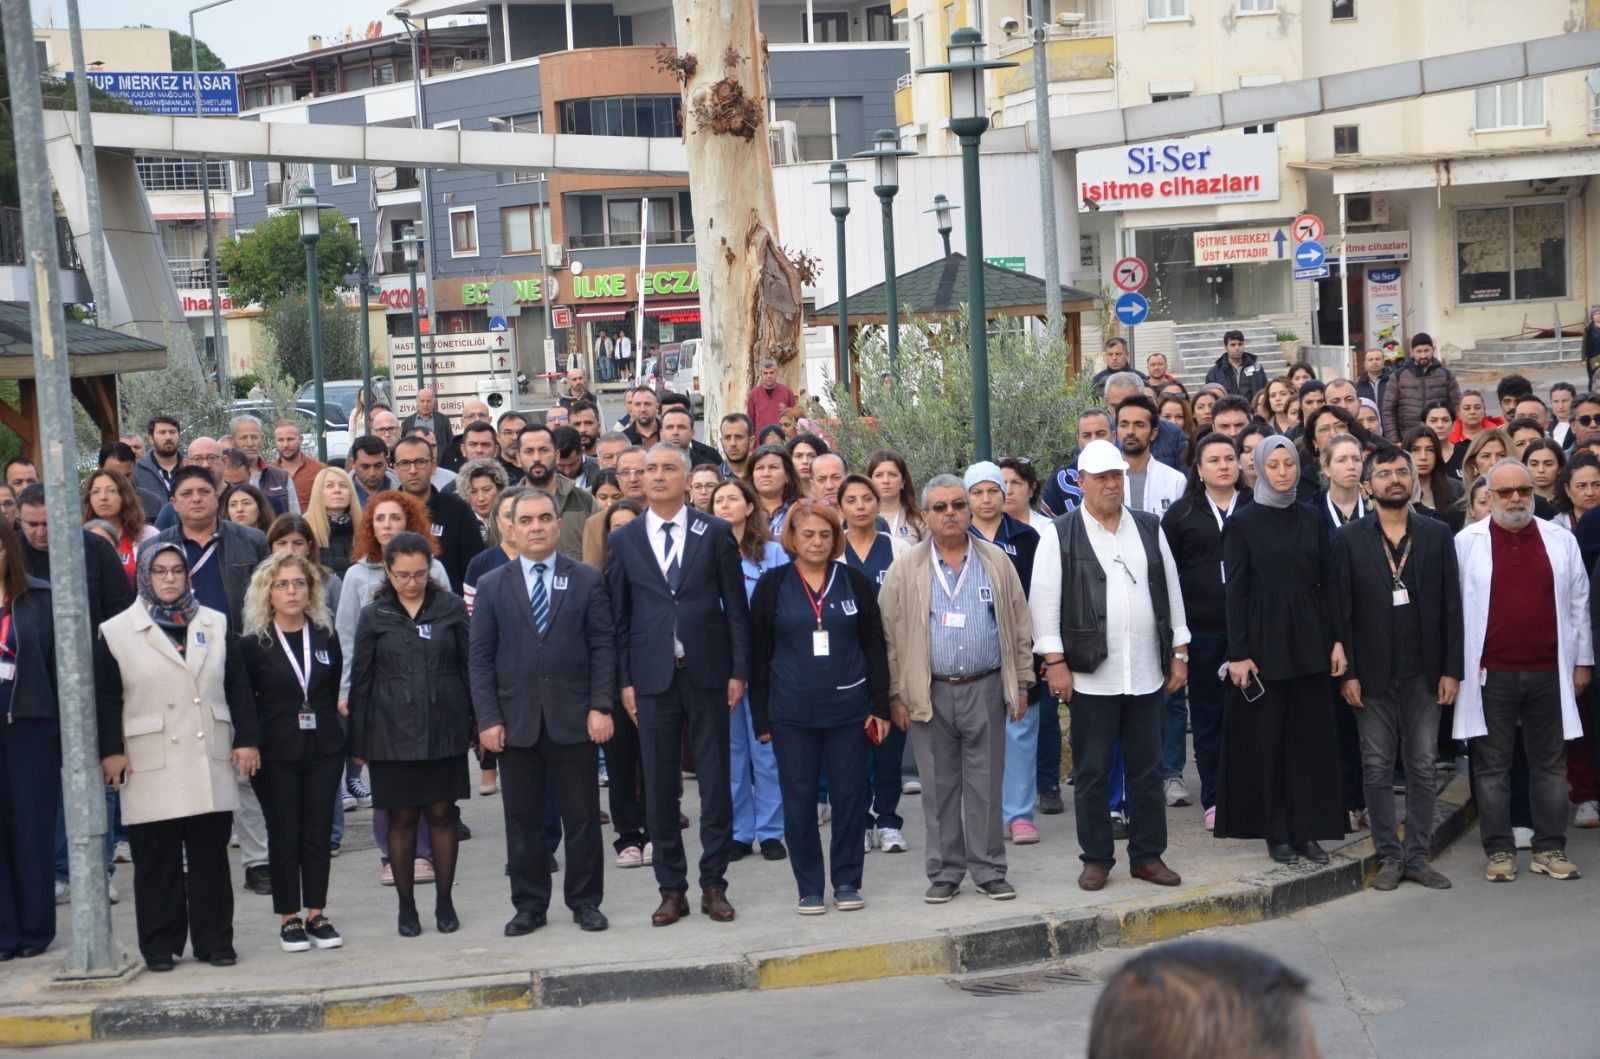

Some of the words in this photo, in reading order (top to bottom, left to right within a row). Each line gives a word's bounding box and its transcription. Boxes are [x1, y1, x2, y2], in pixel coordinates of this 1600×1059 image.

[119, 75, 179, 90] MERKEZ
[1128, 144, 1211, 175] Si-Ser
[1159, 174, 1260, 197] cihazları
[1196, 235, 1228, 249] İŞİTME
[1230, 232, 1271, 246] MERKEZİ
[1203, 248, 1220, 261] ÜST
[1223, 247, 1268, 260] KATTADIR
[557, 311, 568, 325] E
[395, 341, 430, 351] HASTNE
[398, 384, 416, 392] ACİL
